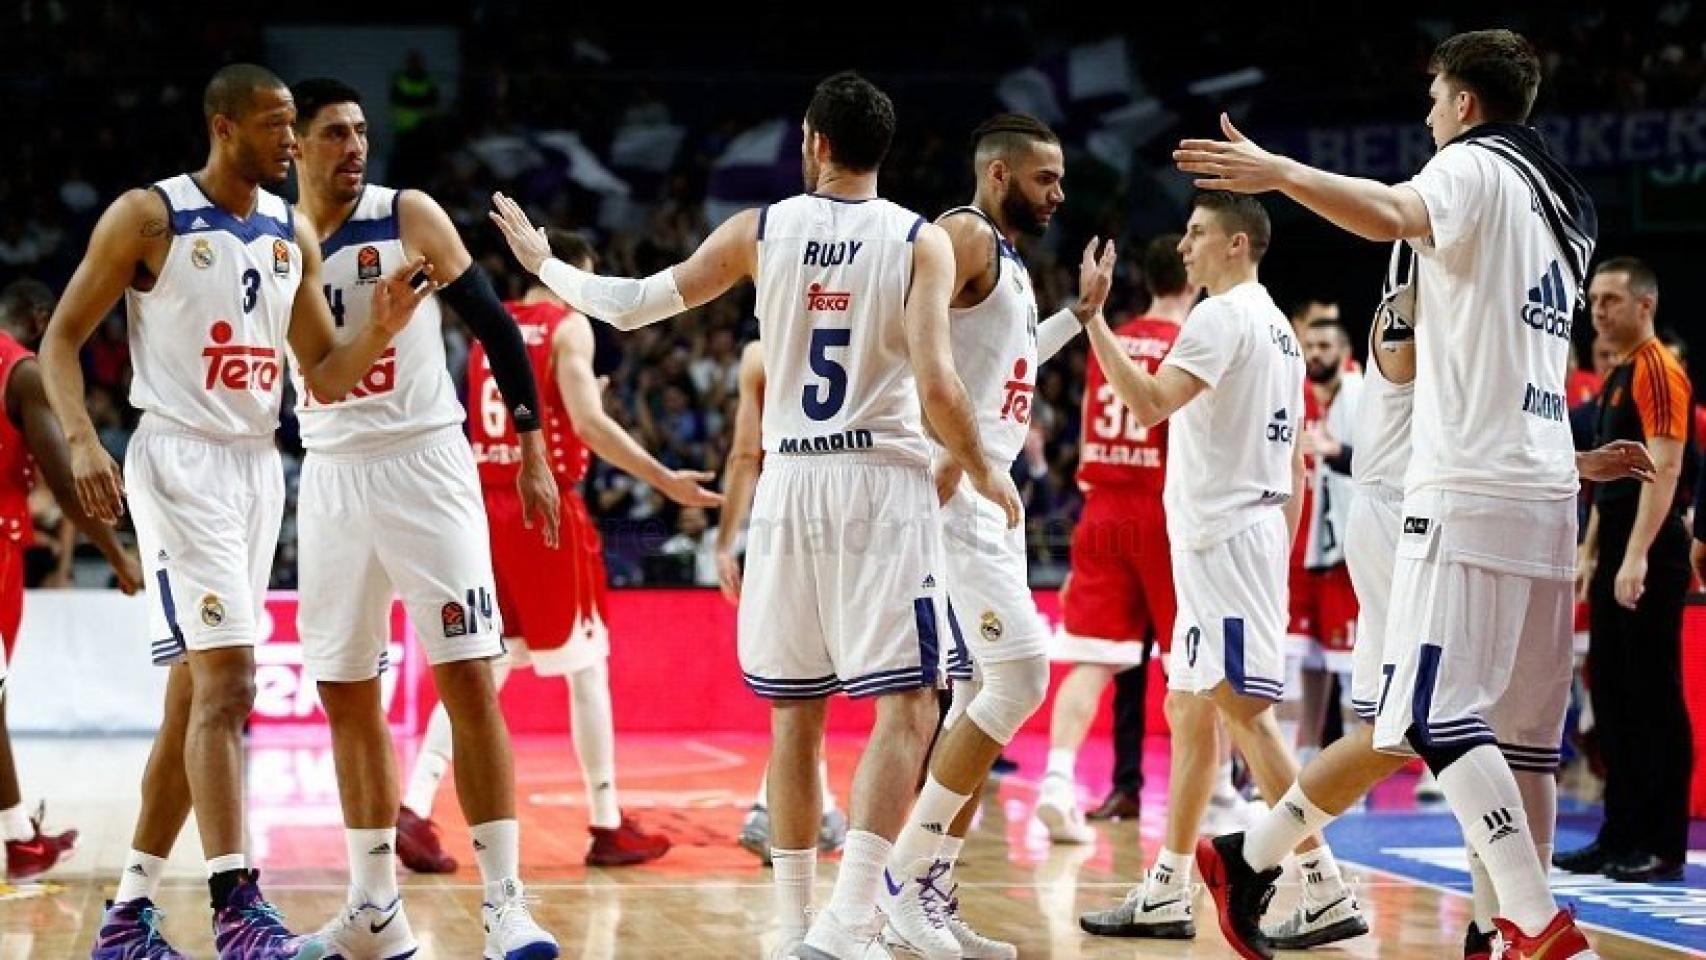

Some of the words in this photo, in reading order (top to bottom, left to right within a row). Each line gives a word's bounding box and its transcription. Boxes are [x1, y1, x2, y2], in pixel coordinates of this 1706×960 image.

[242, 268, 261, 314] 3
[807, 290, 851, 311] Teka
[802, 328, 851, 421] 5
[779, 429, 874, 454] MADRID
